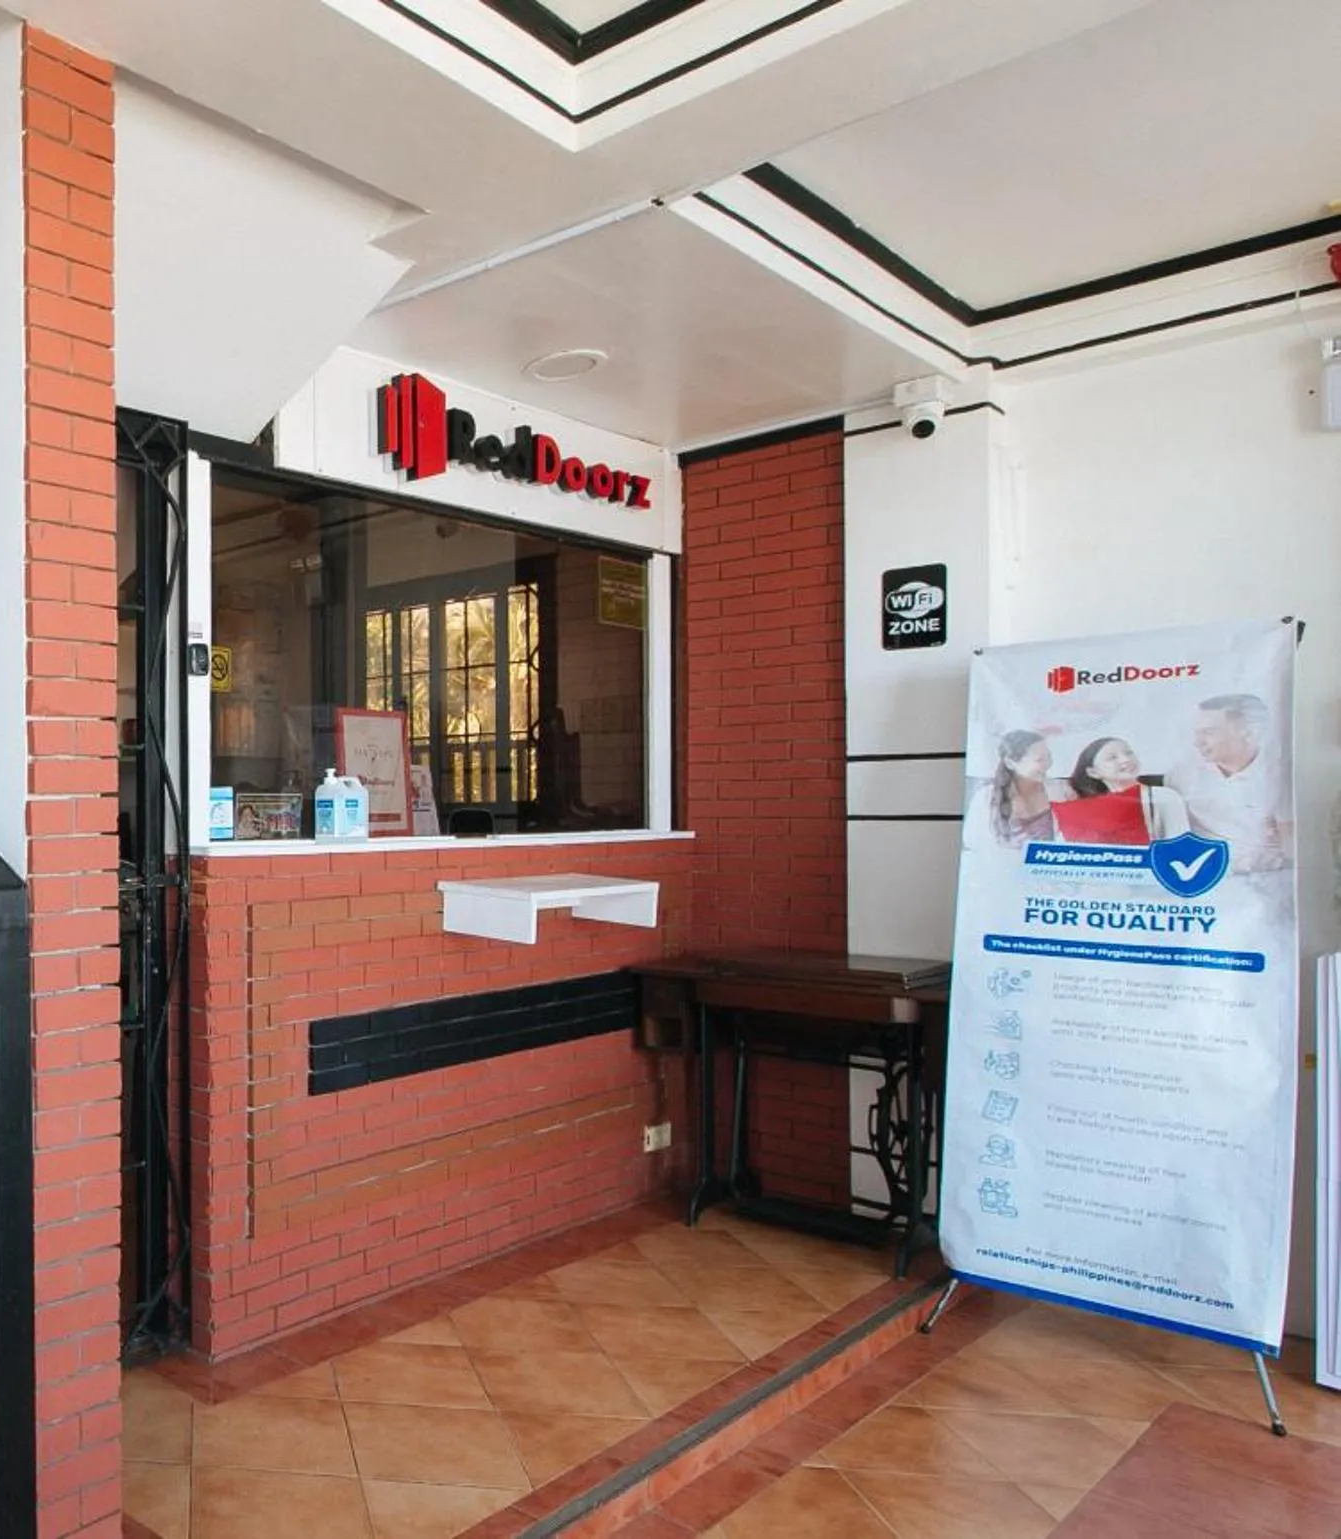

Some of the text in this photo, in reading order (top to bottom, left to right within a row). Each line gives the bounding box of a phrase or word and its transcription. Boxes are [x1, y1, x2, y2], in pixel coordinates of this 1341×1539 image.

[447, 408, 651, 509] RedDoorz
[888, 618, 941, 635] ZONE
[1076, 664, 1201, 685] RedDoorz
[1035, 850, 1143, 863] HygienePass
[1025, 897, 1216, 916] THE GOLDEN STANDARD
[1024, 907, 1217, 934] FOR QUALITY
[991, 939, 1011, 948] The
[1012, 941, 1061, 952] checklist
[1064, 946, 1096, 955] under
[1098, 949, 1172, 960] HygienePass
